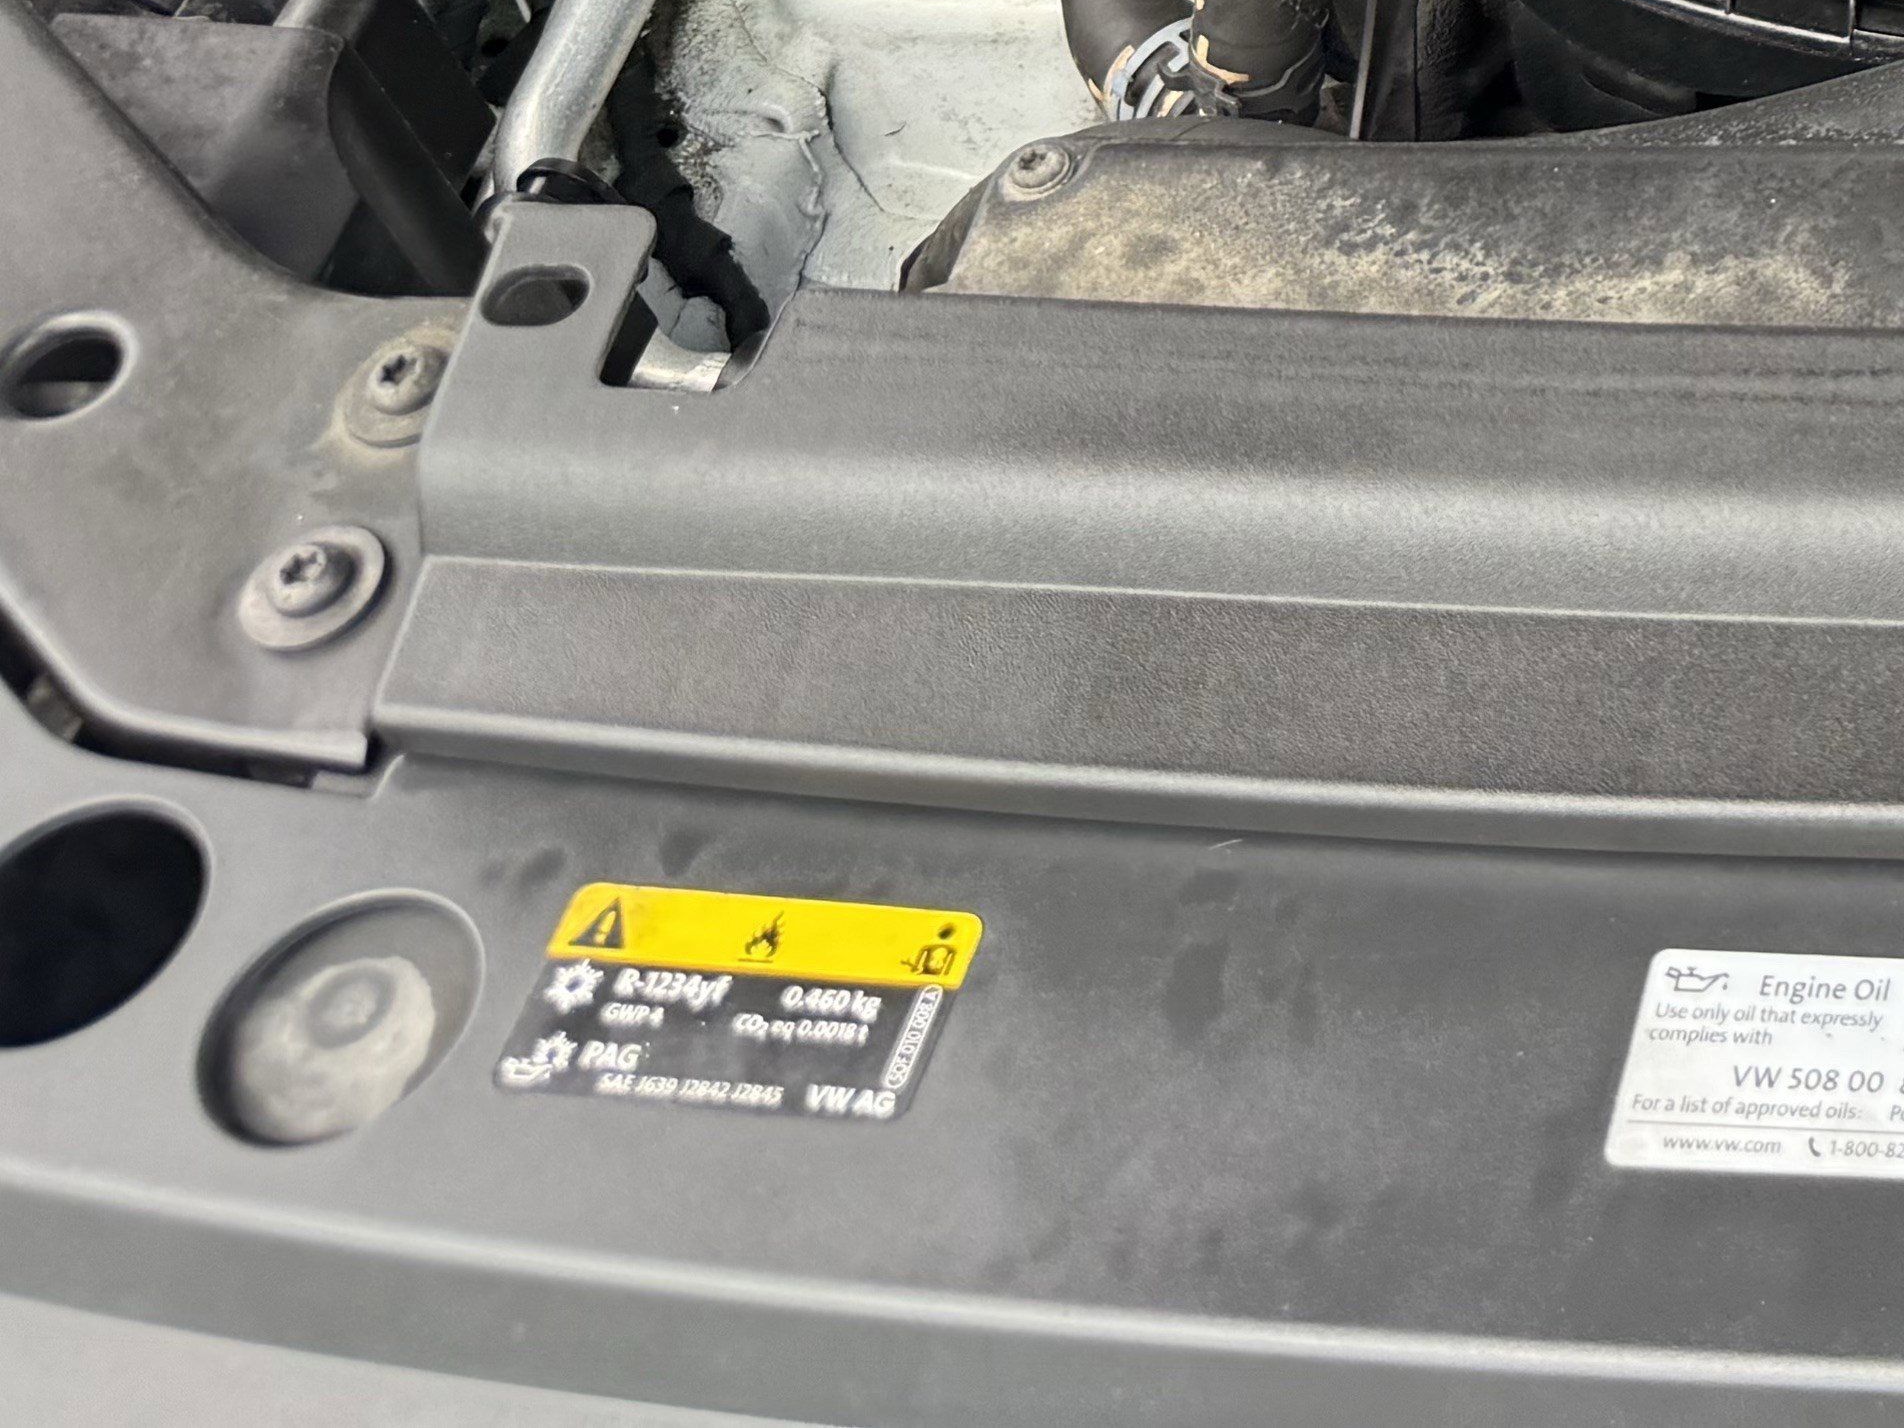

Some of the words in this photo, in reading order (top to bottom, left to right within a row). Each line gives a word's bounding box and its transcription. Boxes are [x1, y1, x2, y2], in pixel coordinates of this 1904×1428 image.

[613, 967, 732, 1012] R-1234yf
[780, 985, 850, 1014] 0.460
[851, 990, 881, 1023] kg
[1758, 974, 1847, 1006] Engine
[1853, 977, 1891, 1002] Oil
[602, 1002, 649, 1026] GWP
[650, 1007, 664, 1028] 4
[1654, 1001, 1689, 1020] Use
[1691, 1002, 1731, 1027] only
[1732, 1004, 1757, 1022] oil
[1759, 1006, 1797, 1025] that
[1800, 1010, 1884, 1034] expressly
[770, 1021, 795, 1042] eq
[797, 1020, 859, 1045] 0.0018
[858, 1024, 869, 1046] t
[1644, 1026, 1728, 1047] complies
[1732, 1028, 1773, 1046] with
[579, 1040, 641, 1073] PAG
[600, 1072, 635, 1093] SAE
[637, 1077, 678, 1097] J639
[679, 1079, 731, 1102] J2842
[729, 1084, 784, 1108] J2845
[1733, 1065, 1783, 1089] VW
[1787, 1067, 1840, 1092] 508
[1847, 1069, 1885, 1094] 00
[805, 1083, 854, 1113] VW
[851, 1089, 895, 1118] AG
[1631, 1092, 1662, 1112] For
[1663, 1097, 1676, 1113] a
[1679, 1094, 1709, 1114] list
[1711, 1096, 1734, 1115] of
[1733, 1100, 1823, 1121] approved
[1824, 1101, 1864, 1121] oils:
[1662, 1136, 1782, 1154] www.vw.com
